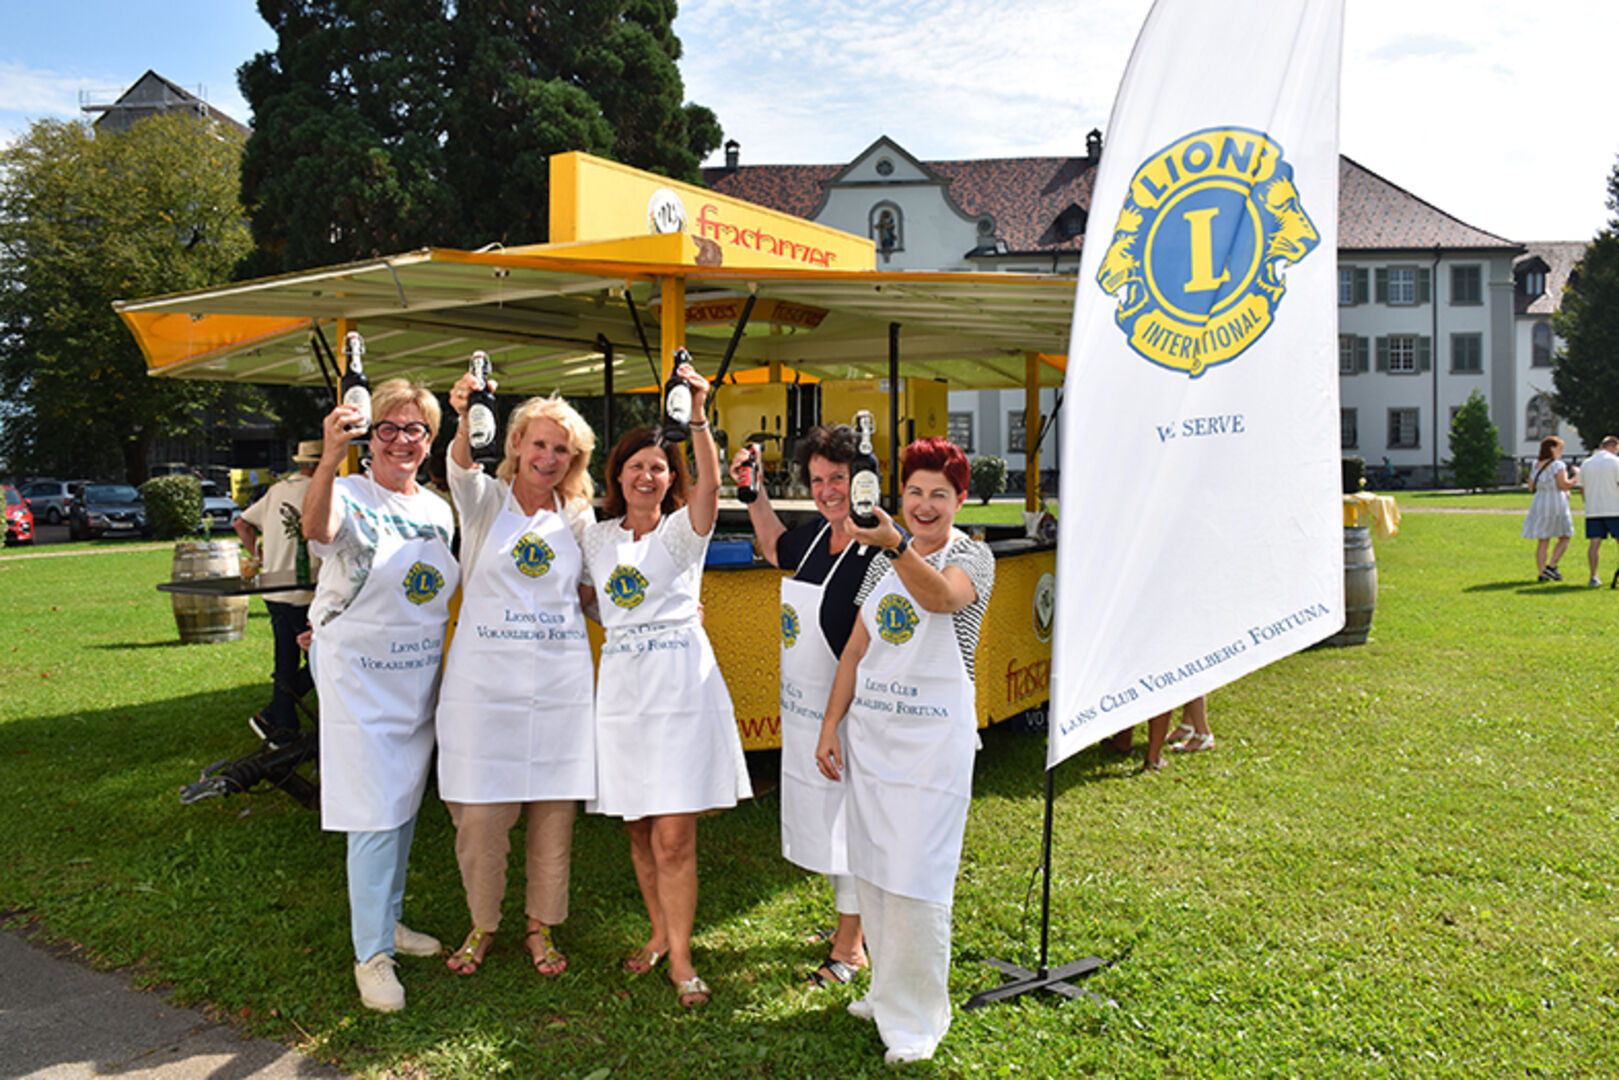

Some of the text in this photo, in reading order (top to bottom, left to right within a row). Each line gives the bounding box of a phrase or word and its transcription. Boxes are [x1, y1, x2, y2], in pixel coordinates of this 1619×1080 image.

[1183, 208, 1231, 293] L
[1182, 414, 1245, 437] SERVE
[1099, 687, 1140, 713] CLUB
[1139, 639, 1247, 694] VORARLBERG
[1247, 602, 1331, 647] FORTUNA
